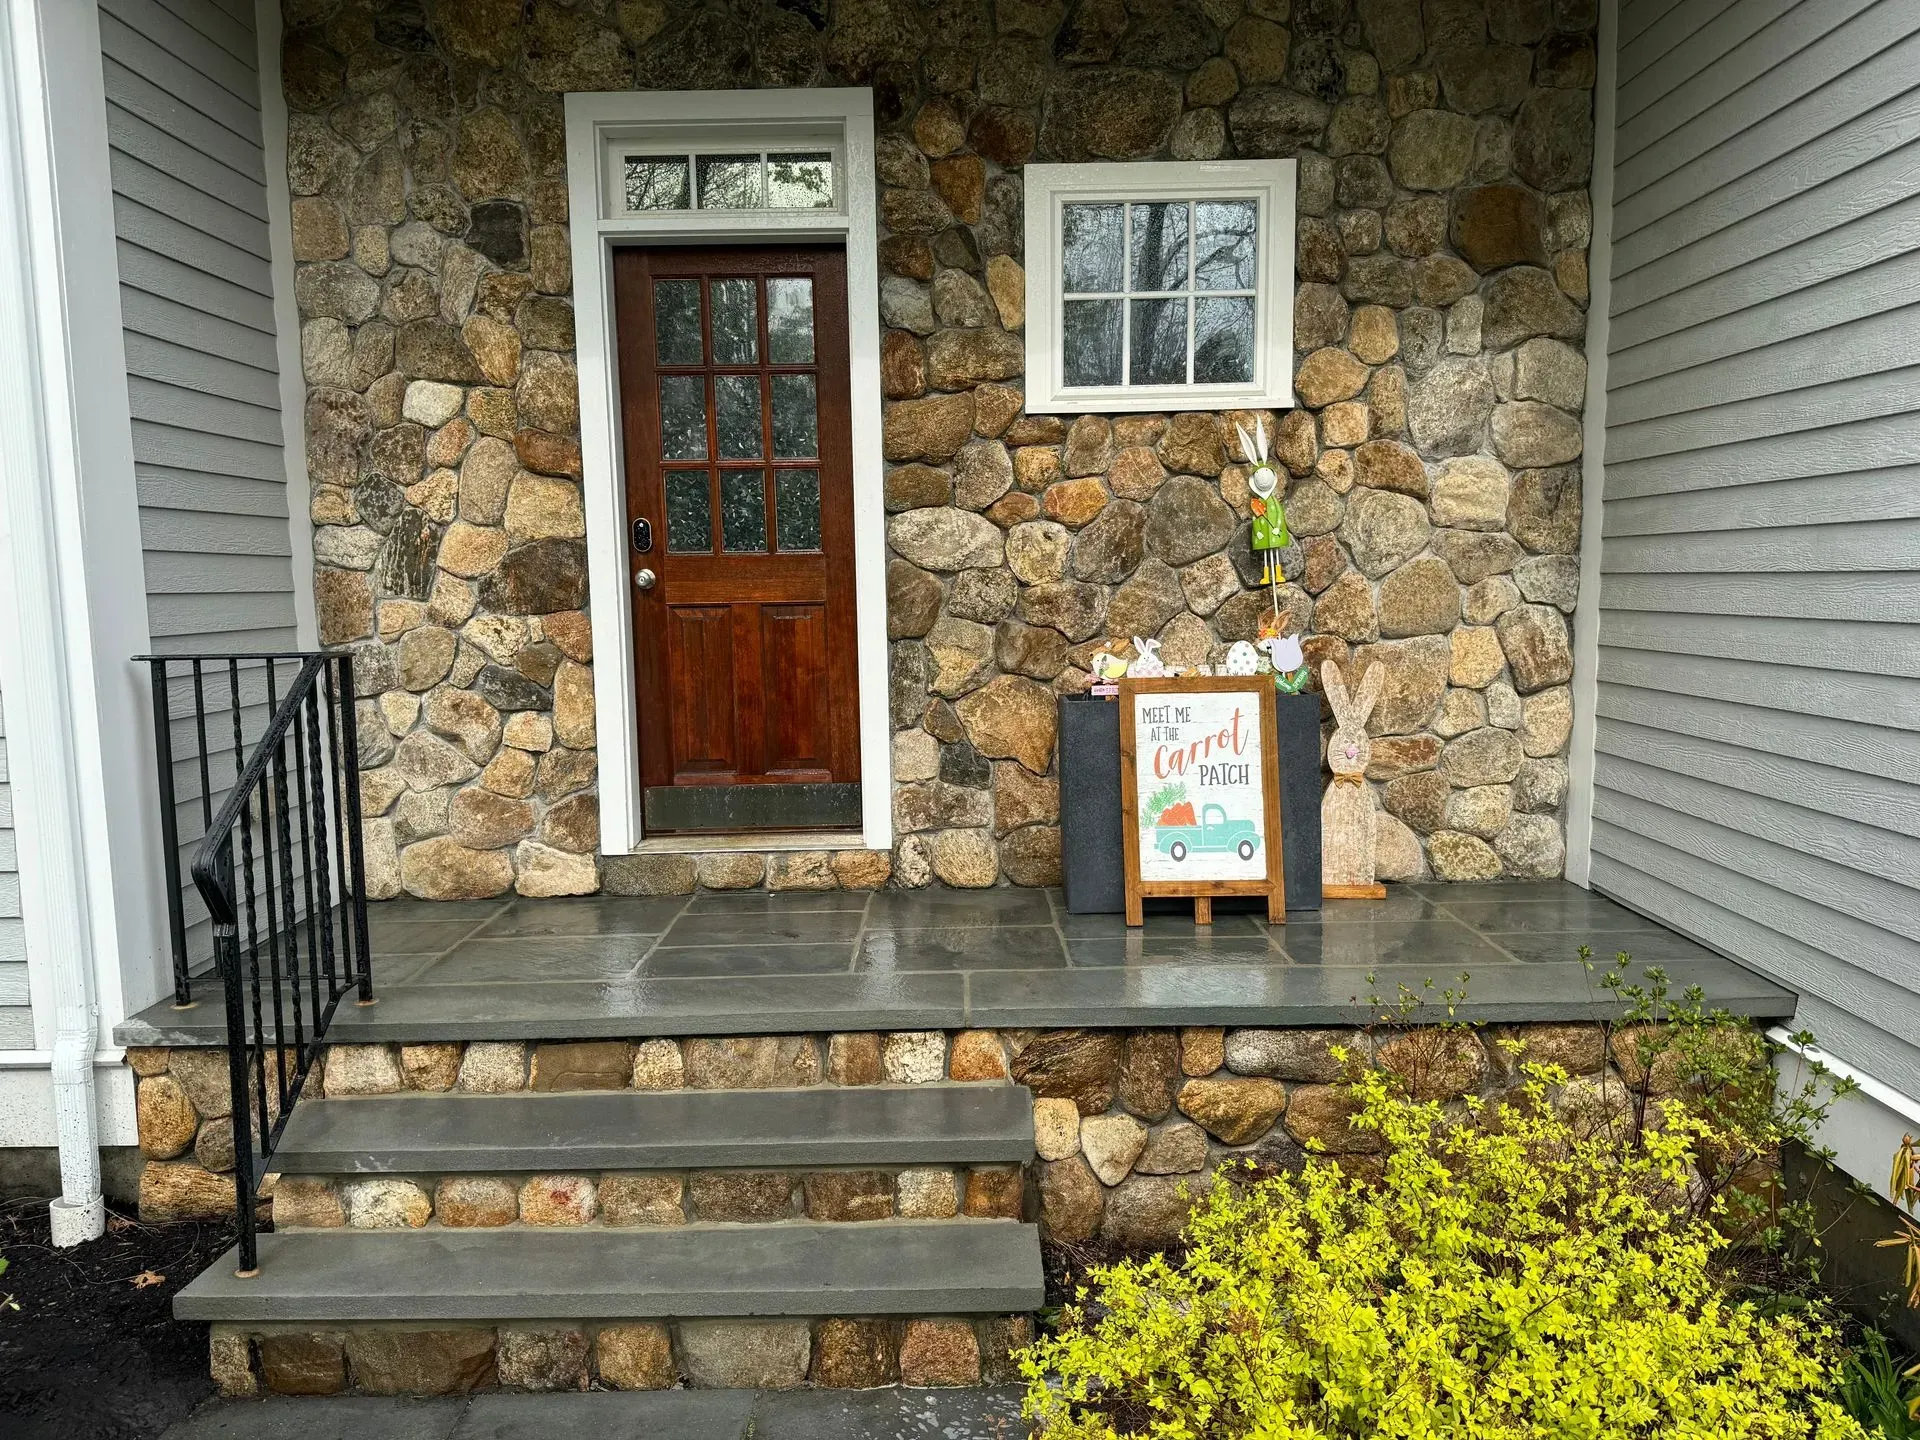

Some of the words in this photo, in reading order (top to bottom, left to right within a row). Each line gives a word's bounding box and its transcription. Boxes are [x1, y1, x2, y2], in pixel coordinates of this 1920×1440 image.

[1142, 705, 1171, 724] MEET
[1175, 706, 1191, 723] ME
[1150, 726, 1162, 741] AT
[1163, 726, 1179, 741] THE
[1153, 707, 1249, 780] Carrot
[1198, 763, 1250, 786] PATCH
